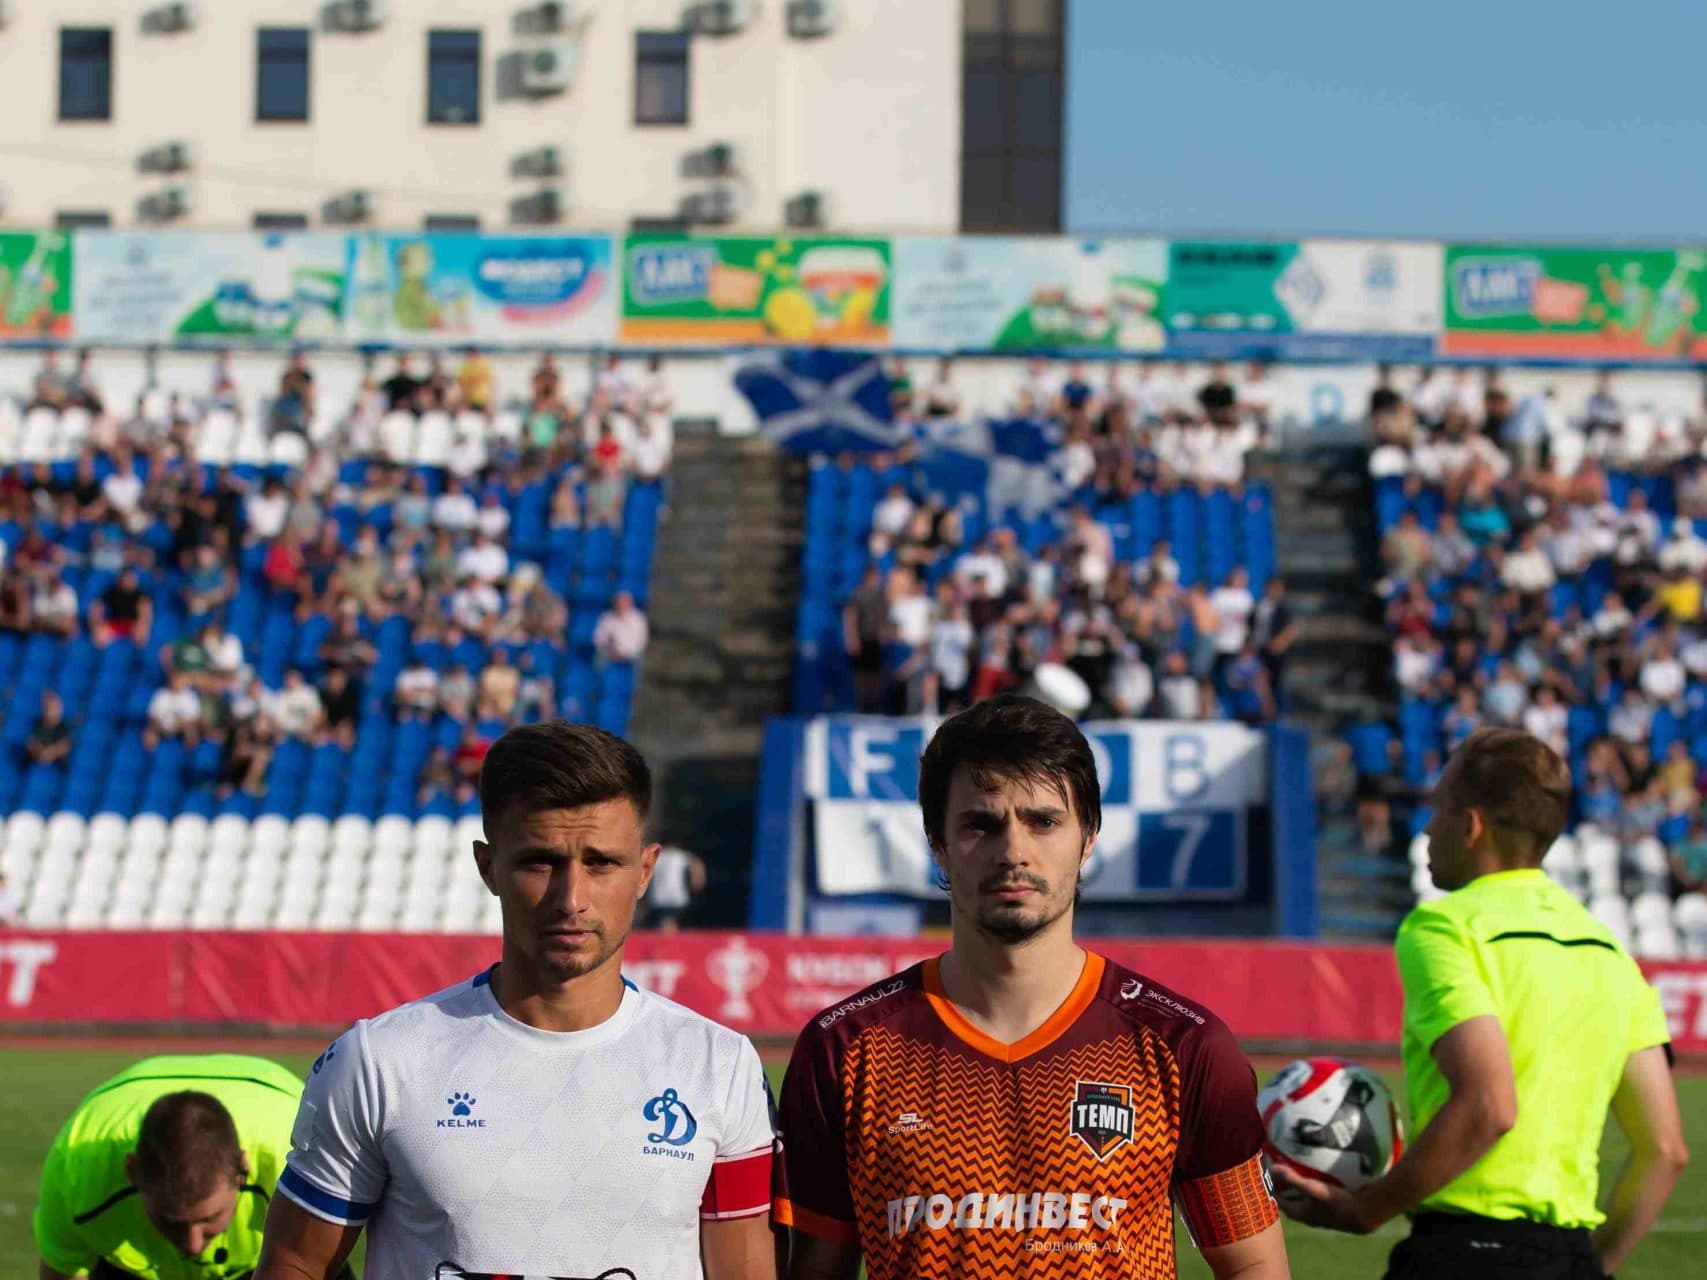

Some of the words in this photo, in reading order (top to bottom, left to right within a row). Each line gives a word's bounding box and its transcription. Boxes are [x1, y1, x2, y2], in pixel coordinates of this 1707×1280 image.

[1145, 990, 1206, 1025] ЭКСКЛЮЗИВ
[436, 1119, 487, 1128] KELME
[1077, 1104, 1129, 1135] ТЕМП
[643, 1146, 695, 1162] БАРНАУЛ
[887, 1192, 1128, 1241] ПРОДИНВЕСТ
